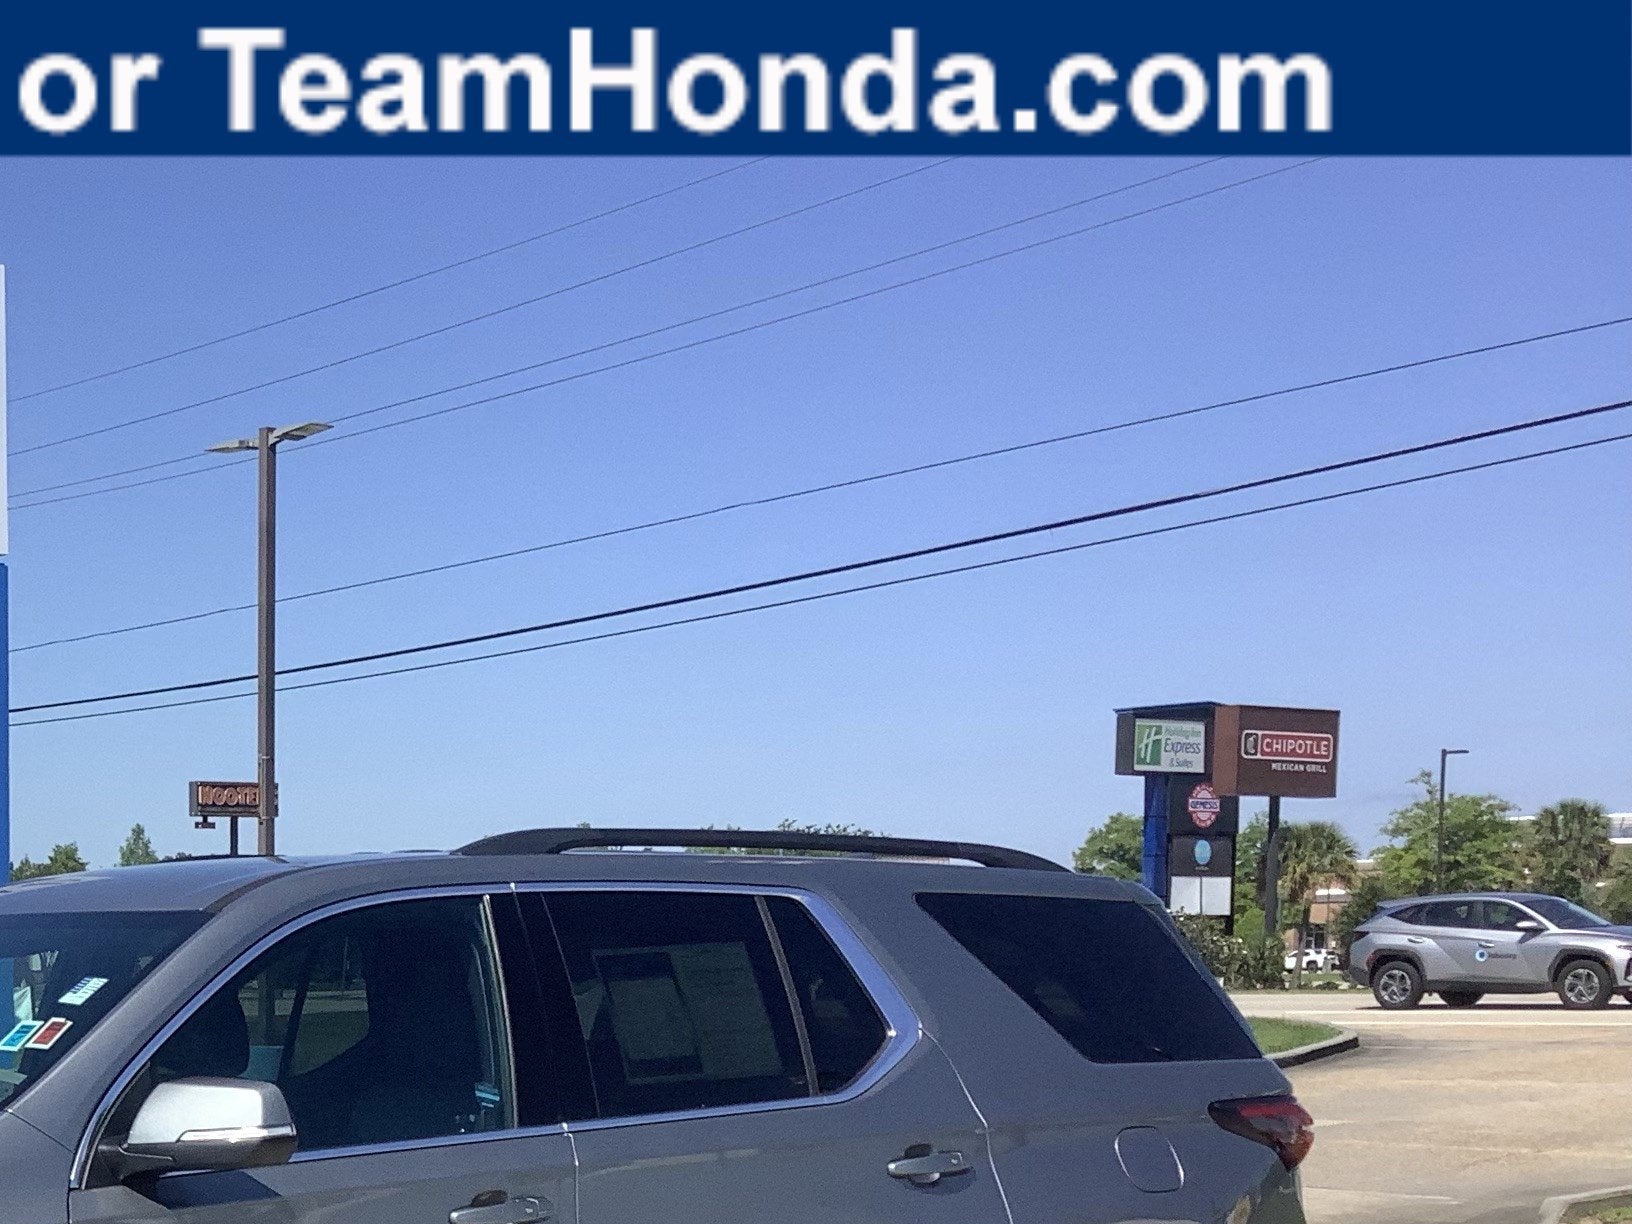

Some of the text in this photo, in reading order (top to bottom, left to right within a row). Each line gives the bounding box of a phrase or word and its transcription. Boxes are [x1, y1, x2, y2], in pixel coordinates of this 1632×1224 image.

[1164, 738, 1202, 755] Express
[1262, 738, 1329, 755] CHIPOTLE
[1176, 758, 1194, 768] Suites
[1271, 762, 1327, 773] MEXICAN GRILL
